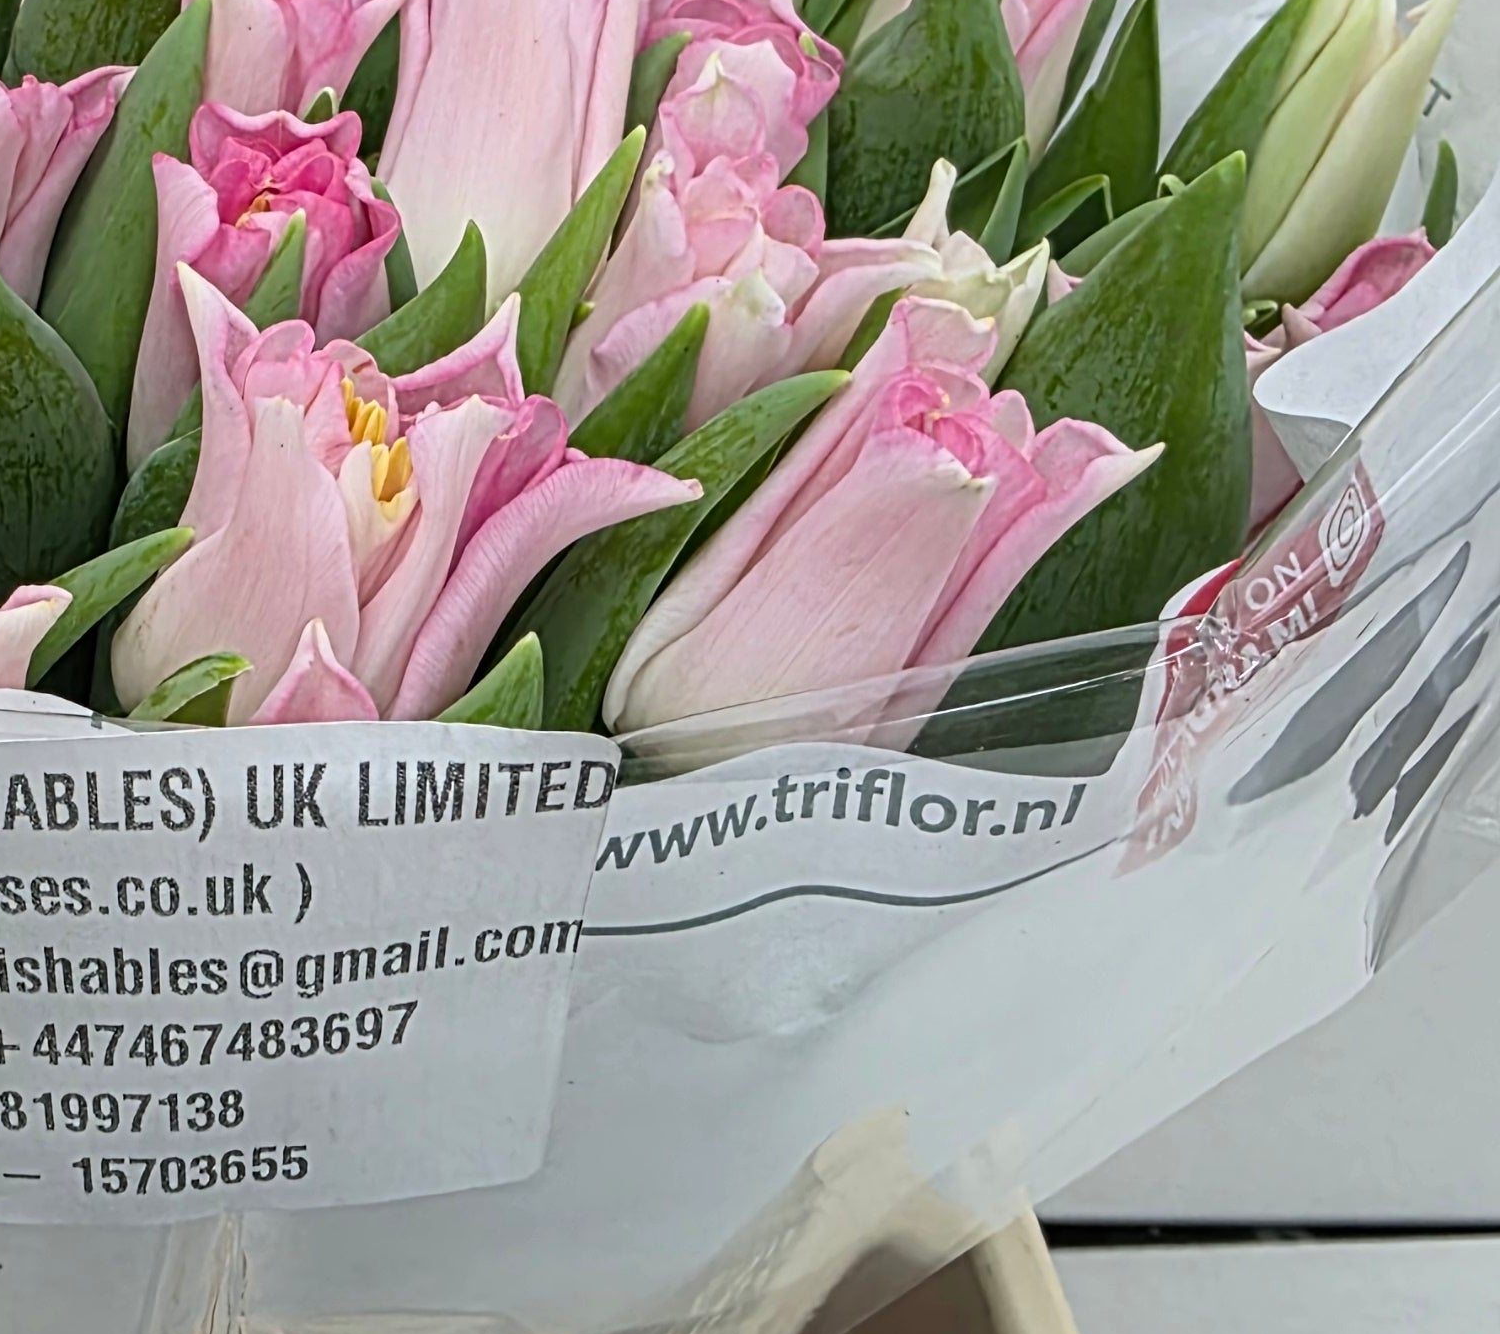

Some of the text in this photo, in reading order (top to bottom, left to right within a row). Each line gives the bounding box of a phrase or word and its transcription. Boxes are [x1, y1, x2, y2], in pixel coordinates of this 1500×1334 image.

[1244, 551, 1303, 612] ON
[246, 763, 328, 829] UK
[356, 760, 617, 829] LIMITED
[596, 767, 1087, 873] www.triflor.nl
[72, 1145, 309, 1197] 15703655
